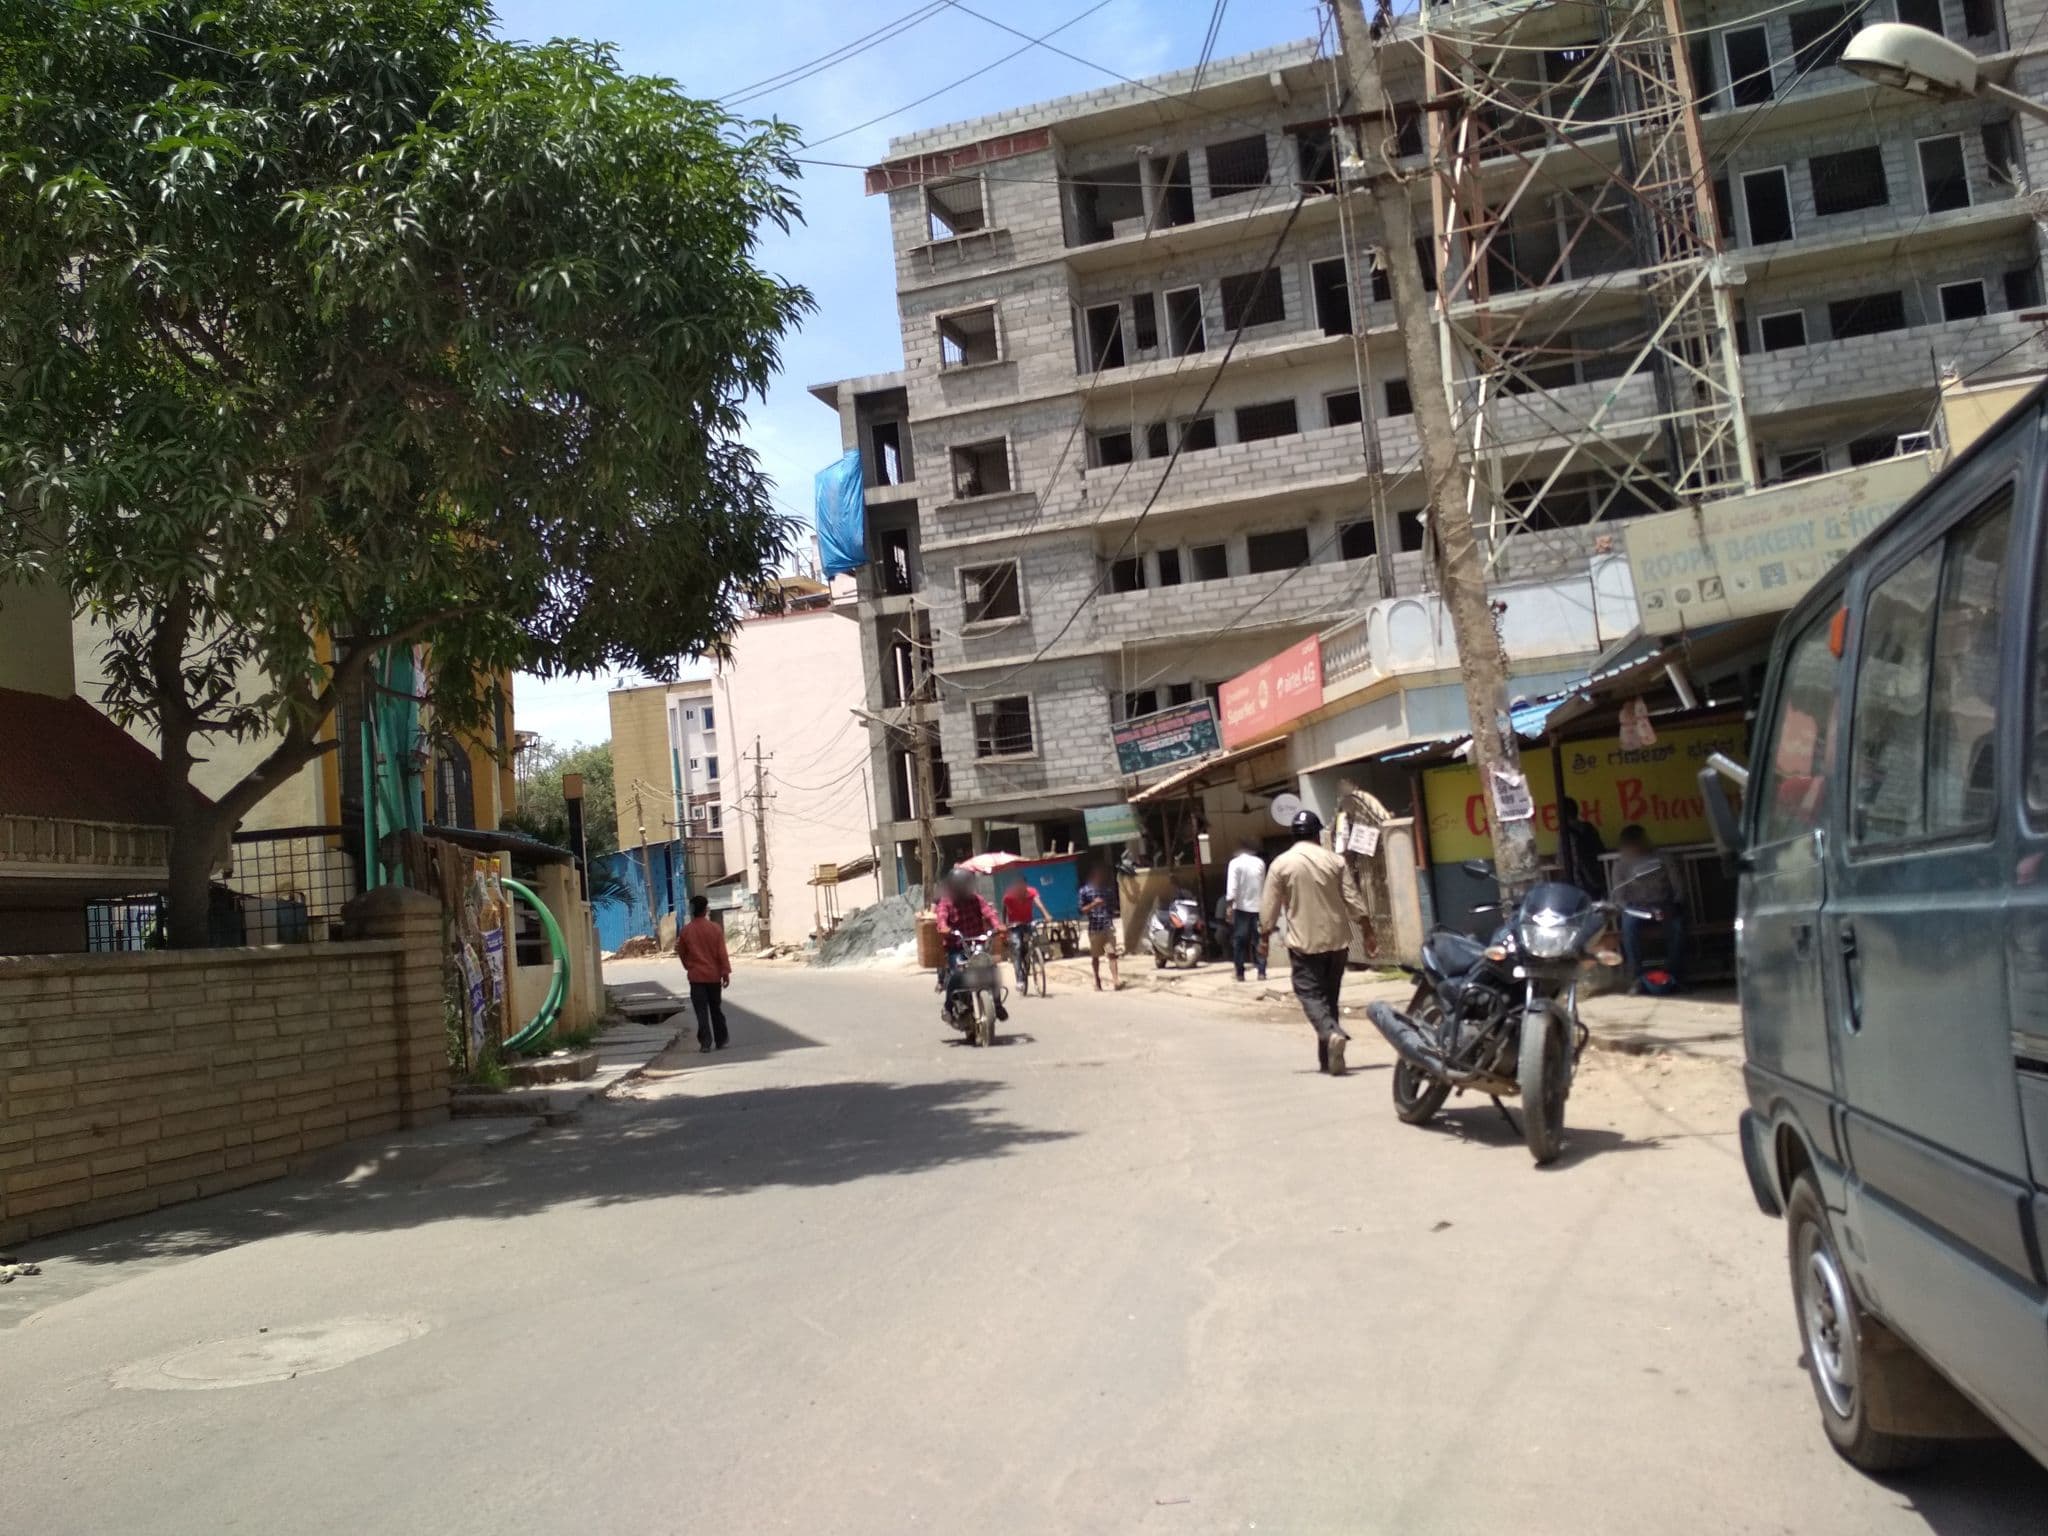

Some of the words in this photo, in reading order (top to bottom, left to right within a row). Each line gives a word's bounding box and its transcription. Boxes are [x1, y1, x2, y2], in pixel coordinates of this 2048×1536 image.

[1725, 518, 1816, 563] BAKERY
[1824, 515, 1842, 542] &
[1303, 661, 1316, 684] 4G
